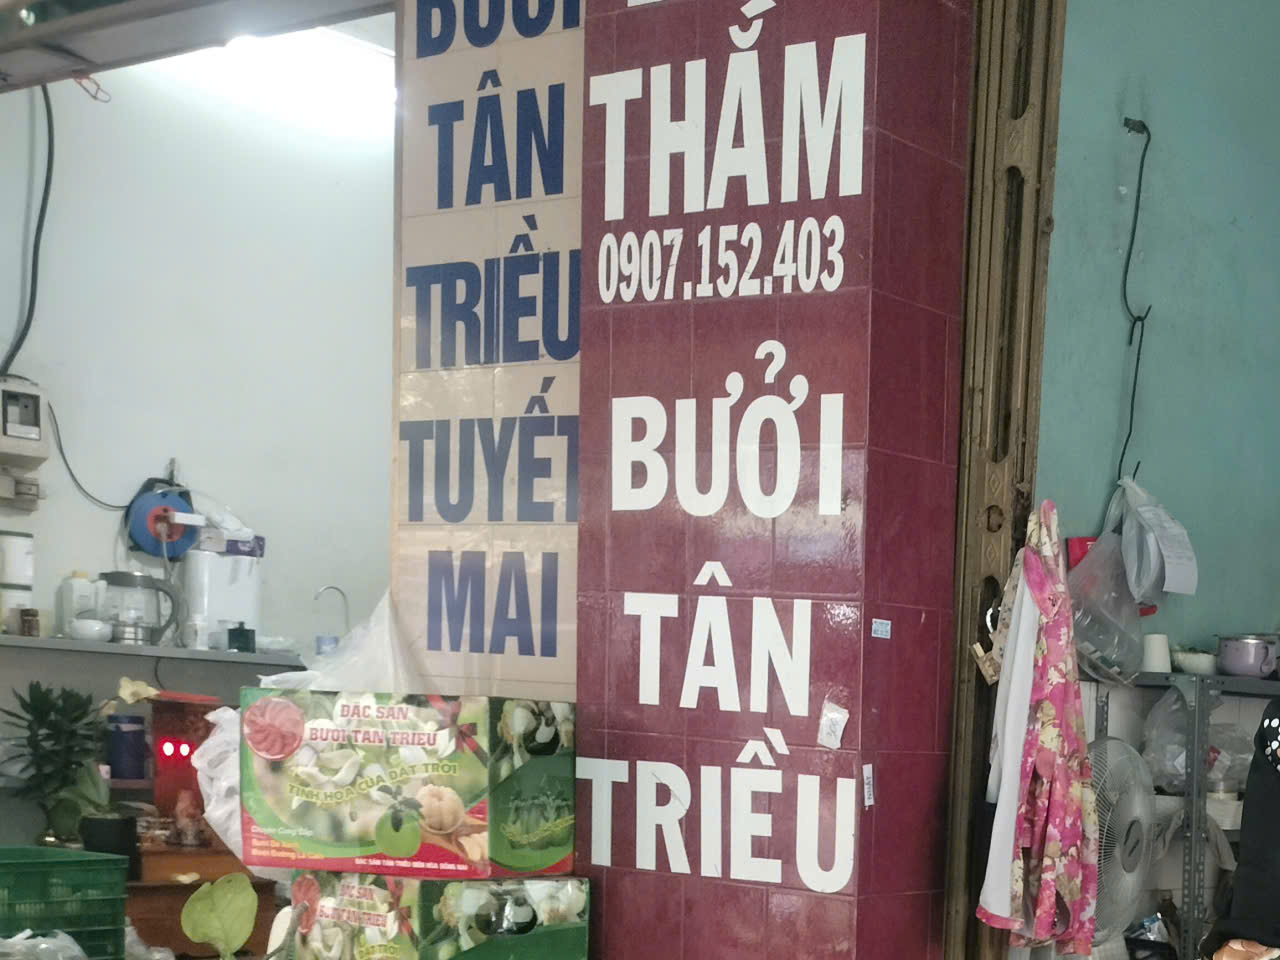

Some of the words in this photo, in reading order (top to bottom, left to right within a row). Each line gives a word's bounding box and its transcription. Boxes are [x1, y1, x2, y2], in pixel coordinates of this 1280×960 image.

[428, 69, 565, 209] TÂN
[589, 0, 866, 221] THẮM
[406, 214, 580, 369] TRIỀU
[598, 215, 844, 304] 0907.152.403
[400, 376, 579, 522] TUYẾT
[611, 340, 844, 518] BƯỞI
[426, 550, 557, 658] MAI
[623, 561, 812, 717] TÂN
[576, 728, 856, 893] TRIỀU
